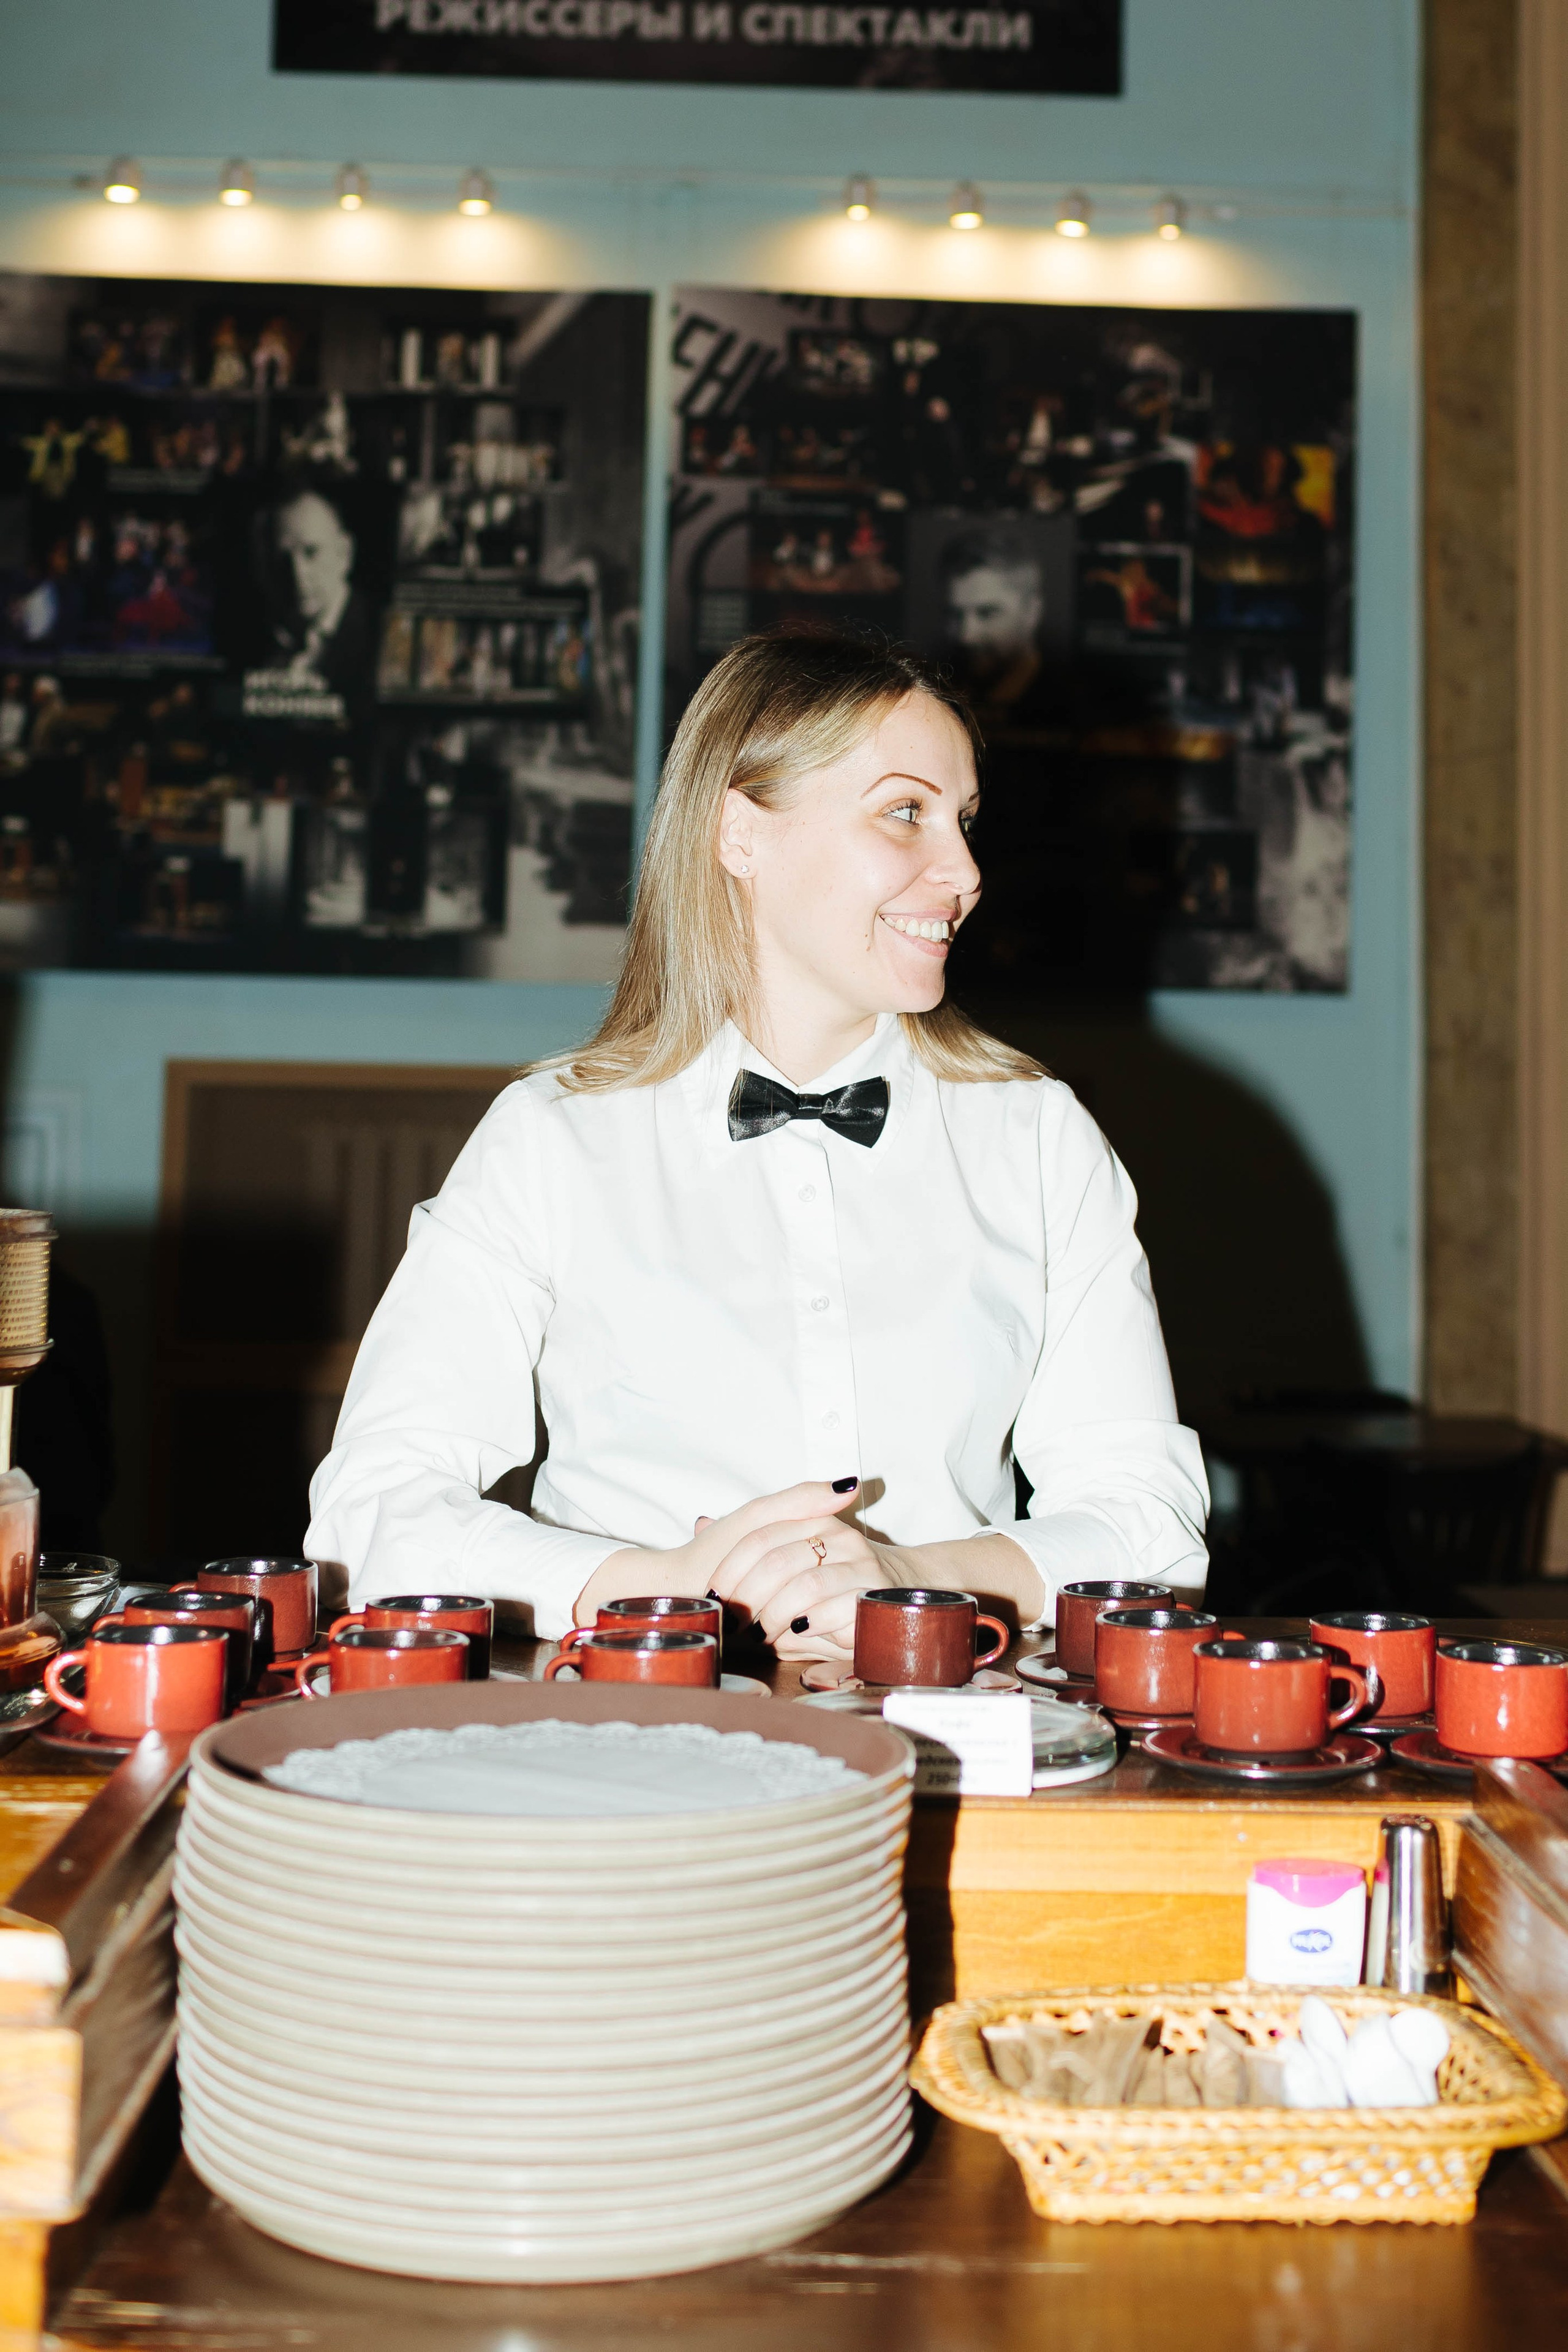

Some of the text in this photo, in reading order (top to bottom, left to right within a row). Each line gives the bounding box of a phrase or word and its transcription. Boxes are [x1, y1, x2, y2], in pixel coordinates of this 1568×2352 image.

[376, 0, 1032, 49] РЕЖИССЕРЫ И СПЕКТАКЛИ
